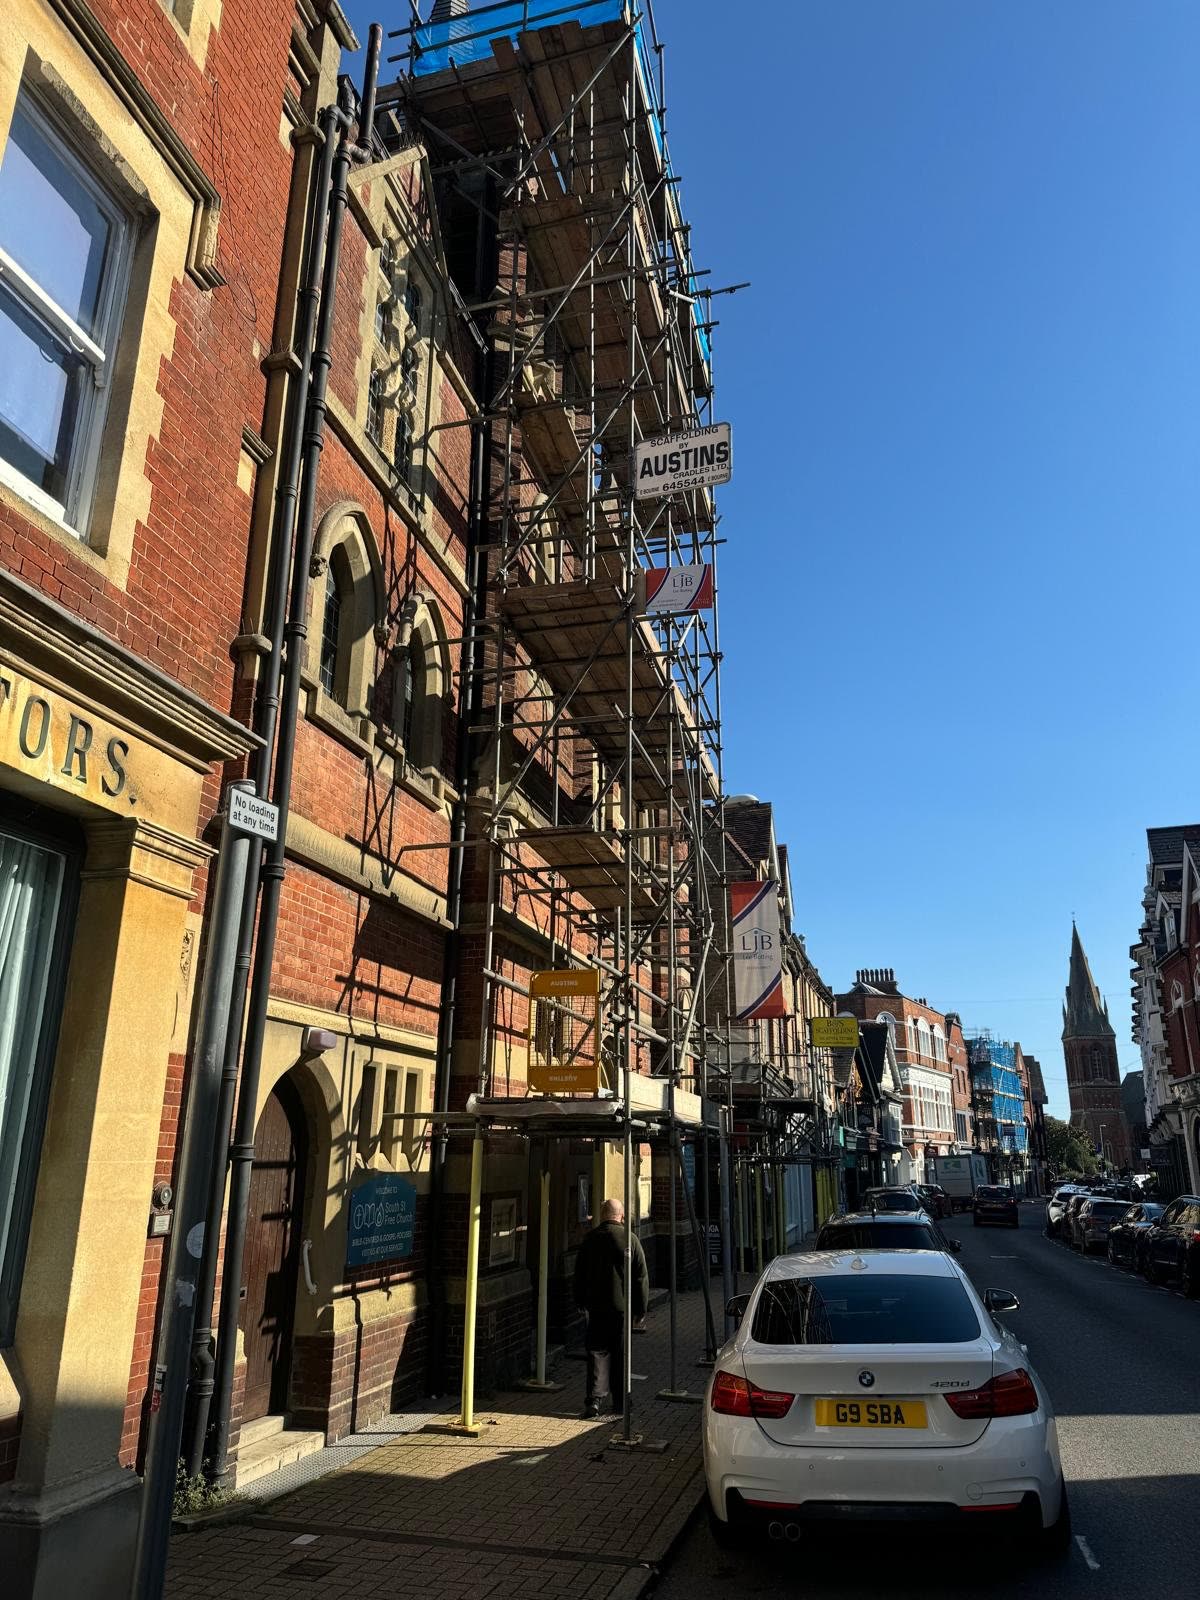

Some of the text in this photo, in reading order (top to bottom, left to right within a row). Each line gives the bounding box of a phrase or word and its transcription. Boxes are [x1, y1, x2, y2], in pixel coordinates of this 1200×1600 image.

[650, 426, 719, 447] SCAFFOLDING
[678, 442, 689, 450] BY
[640, 441, 729, 479] AUSTINS
[673, 465, 710, 479] CRADLES
[662, 476, 705, 492] 645544
[235, 795, 275, 822] No loading
[233, 810, 275, 834] at any time
[385, 1202, 399, 1213] South
[384, 1212, 414, 1225] Free Church
[929, 1380, 970, 1388] 420d
[836, 1403, 905, 1424] G9 SBA
